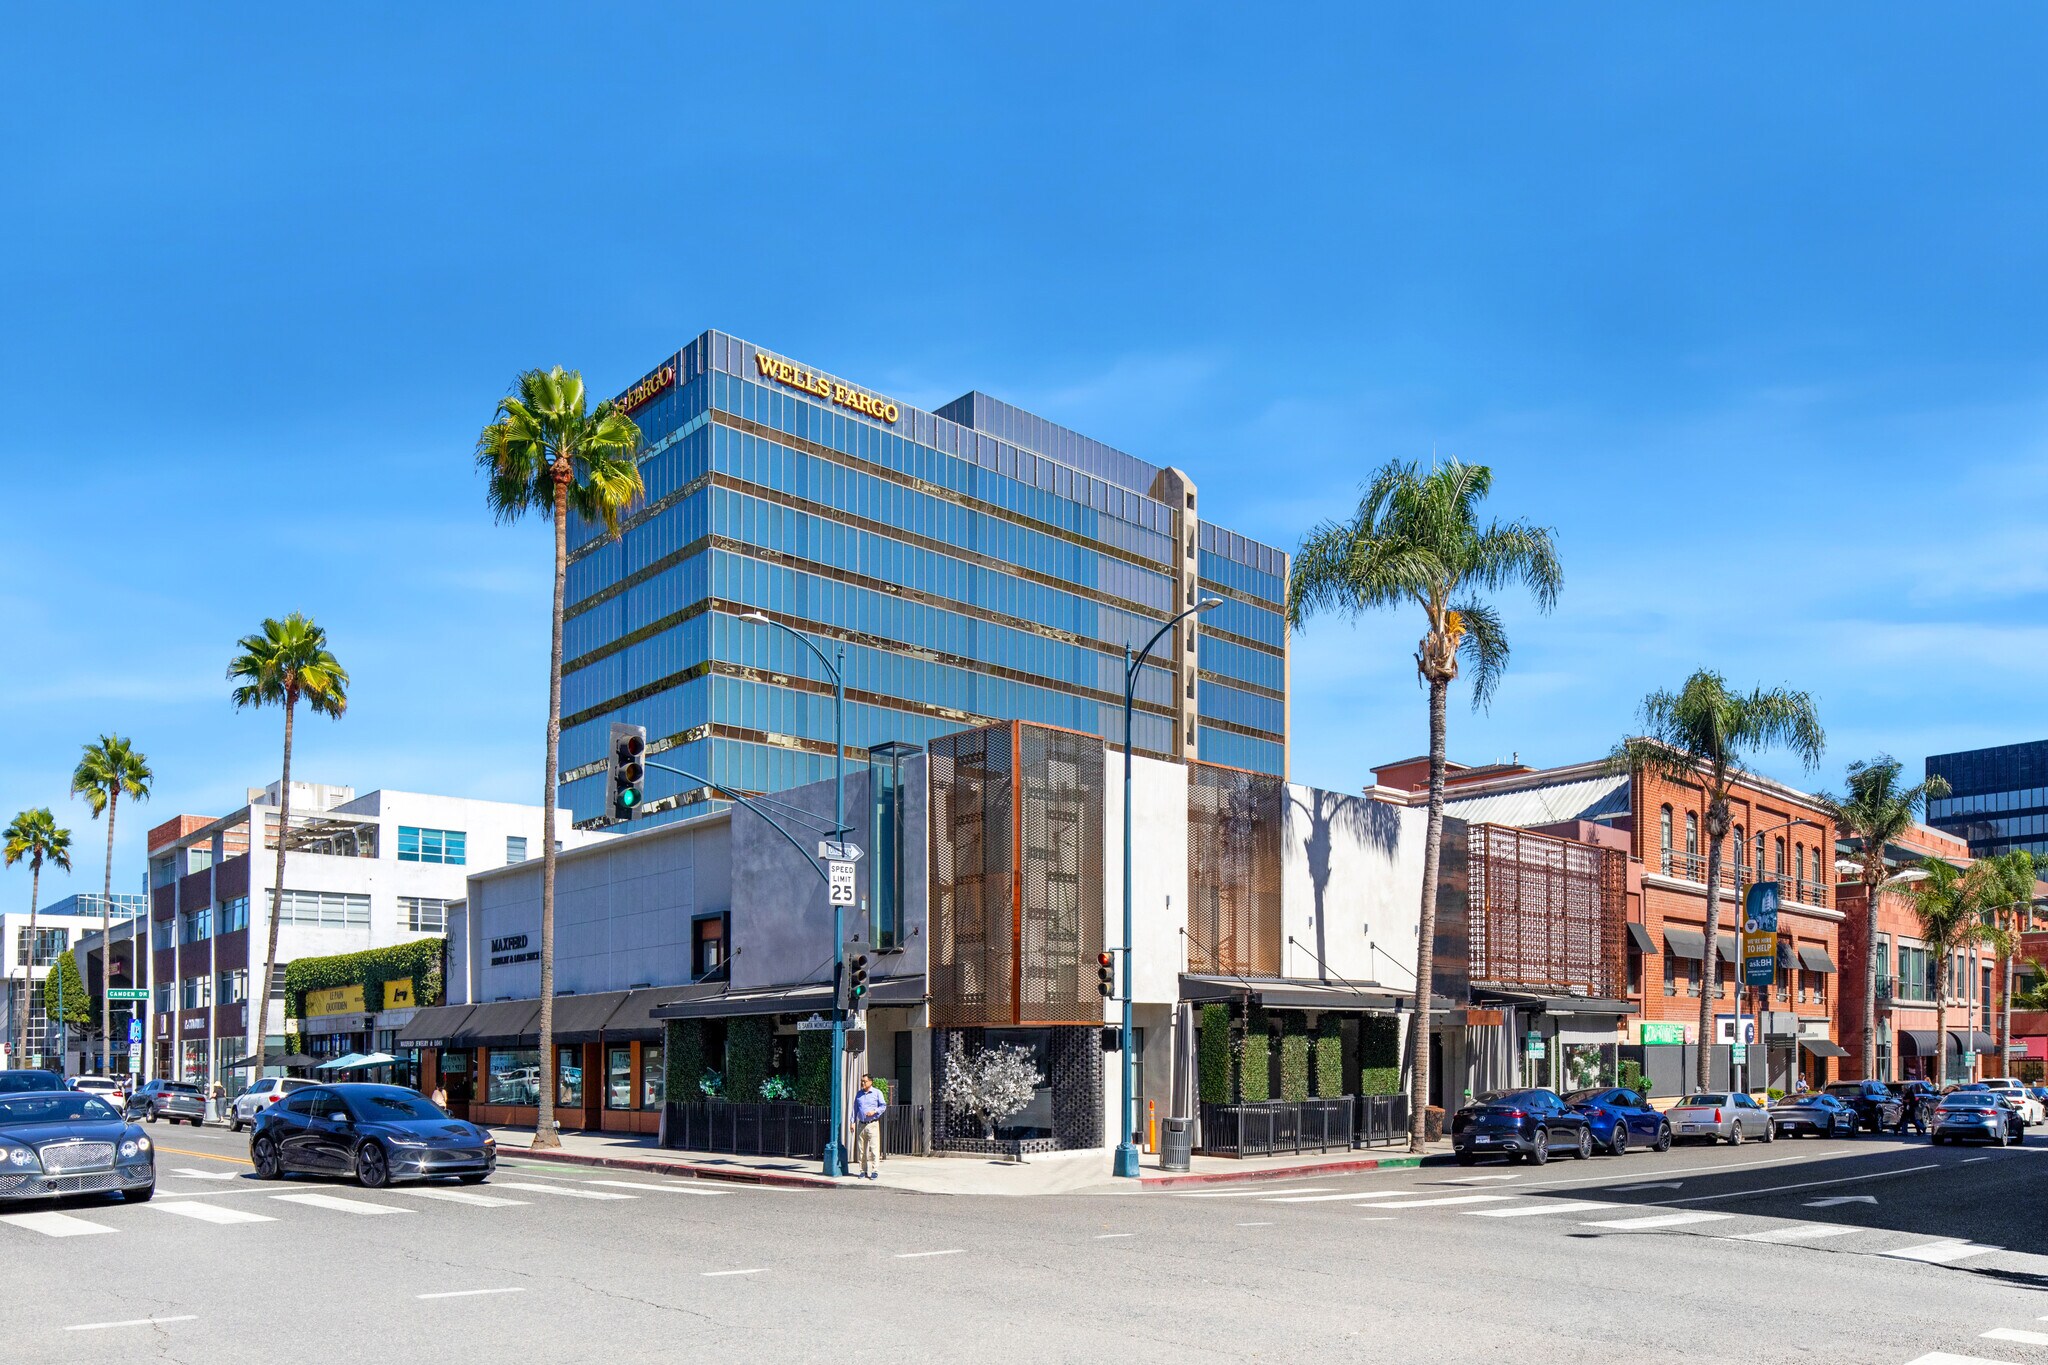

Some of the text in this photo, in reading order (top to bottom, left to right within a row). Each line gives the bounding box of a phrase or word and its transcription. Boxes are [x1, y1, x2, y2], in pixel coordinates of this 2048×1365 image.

[627, 366, 673, 412] FARGO
[755, 353, 899, 424] WELLS FARGO
[831, 865, 854, 874] SPEED
[832, 875, 851, 883] LIMIT
[831, 884, 853, 901] 25
[491, 935, 528, 952] MAXFERD
[1747, 943, 1772, 953] TO HELP
[1749, 958, 1772, 968] askBH
[329, 992, 334, 1000] LE
